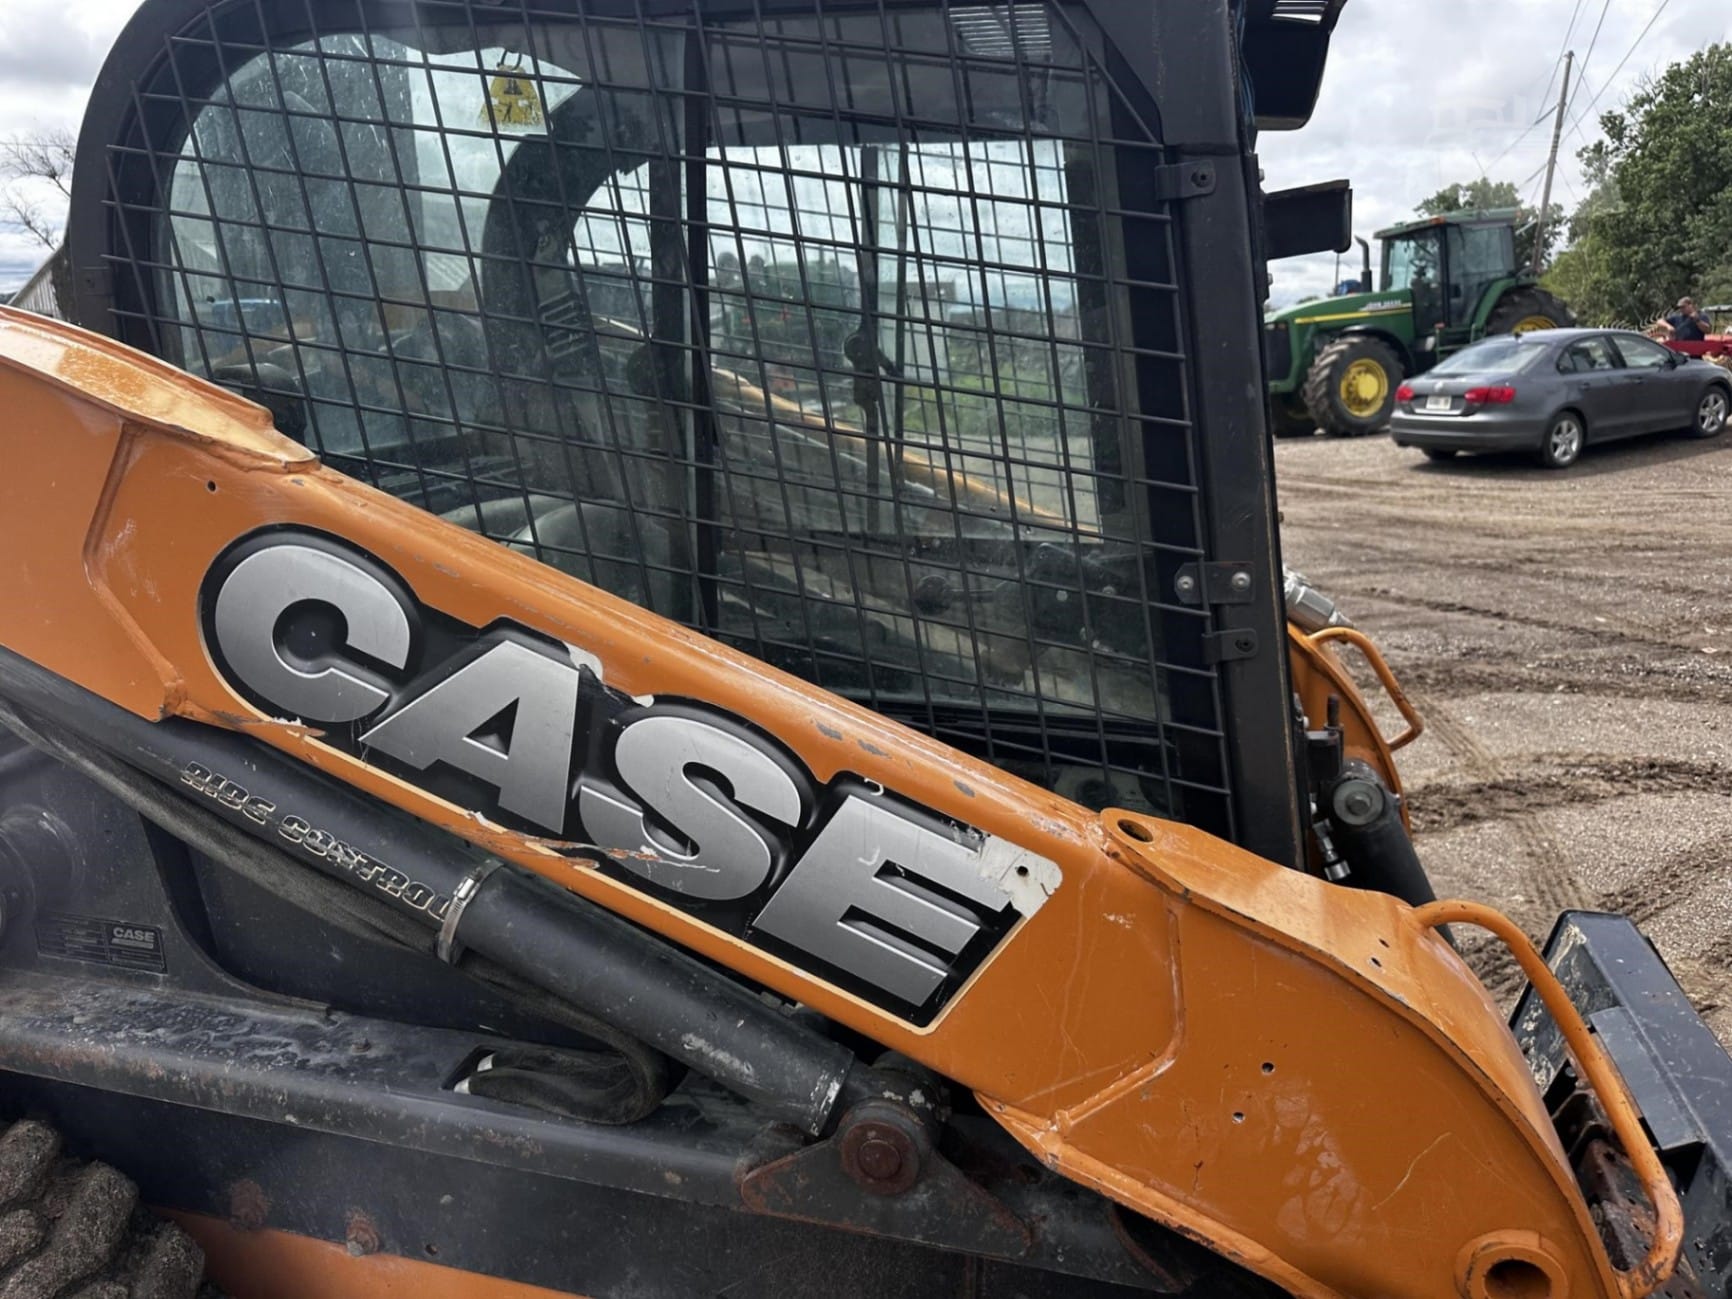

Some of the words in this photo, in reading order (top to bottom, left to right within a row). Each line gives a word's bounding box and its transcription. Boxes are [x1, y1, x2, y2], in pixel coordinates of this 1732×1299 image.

[180, 760, 276, 825] RIDE
[205, 545, 1012, 1008] CASE
[113, 927, 155, 942] CASE
